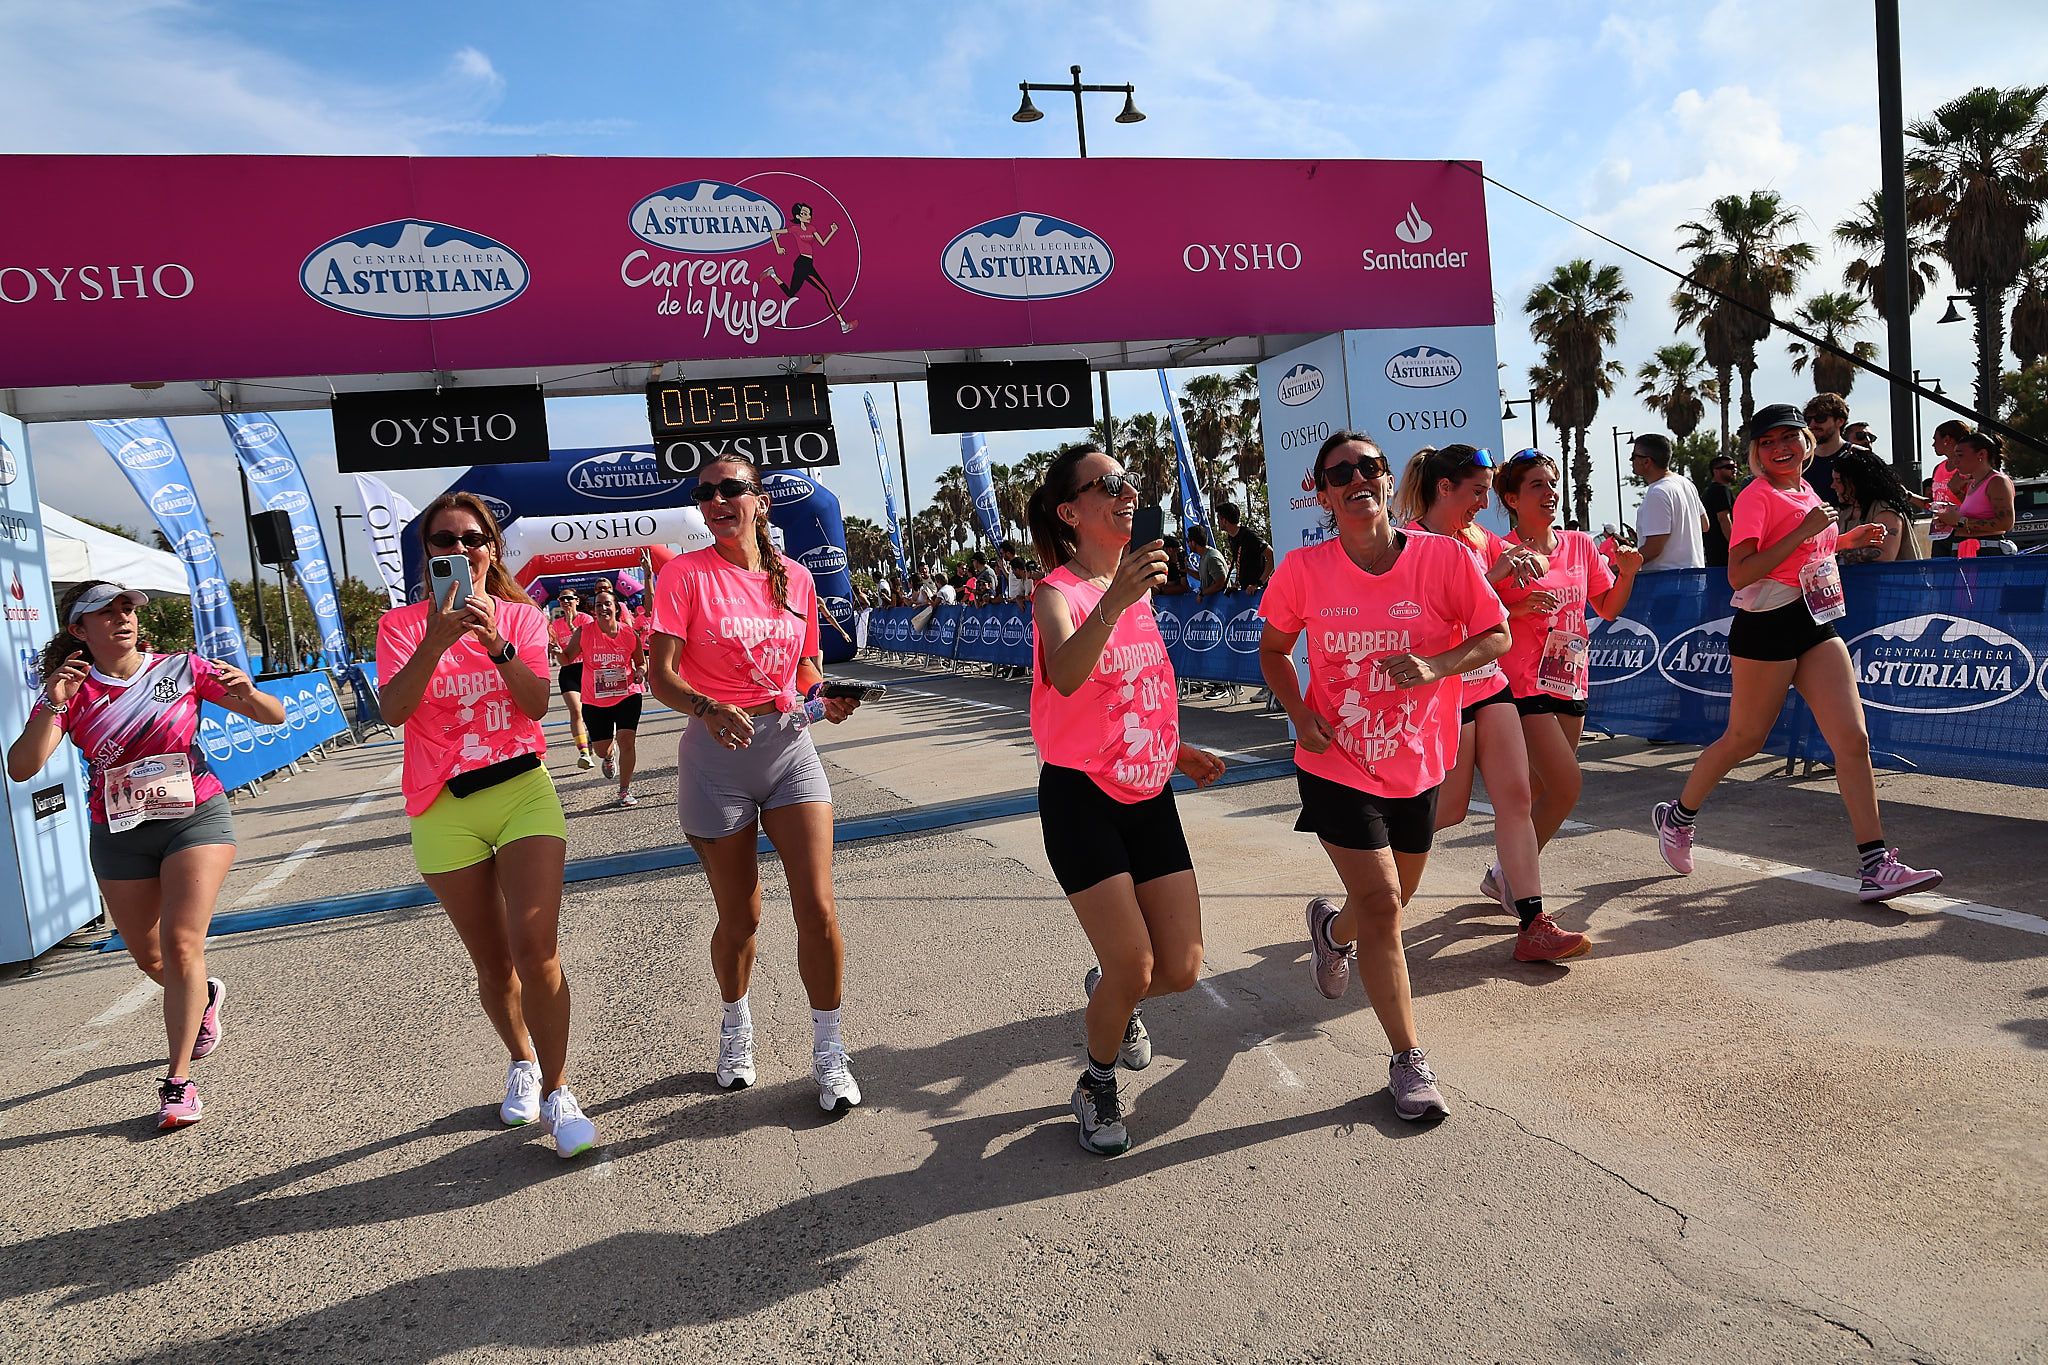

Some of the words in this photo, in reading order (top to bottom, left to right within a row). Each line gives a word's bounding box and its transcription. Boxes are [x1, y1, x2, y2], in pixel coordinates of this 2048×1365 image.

[642, 207, 774, 235] ASTURIANA
[665, 205, 713, 213] CENTRAL
[718, 205, 767, 213] LECHERA
[352, 254, 425, 265] CENTRAL
[432, 253, 503, 263] LECHERA
[981, 243, 1036, 253] CENTRAL
[1041, 242, 1095, 251] LECHERA
[1183, 242, 1303, 273] OYSHO
[1362, 247, 1469, 271] Santander
[620, 250, 751, 288] Carrera
[956, 247, 1102, 280] ASTURIANA
[0, 263, 195, 304] OYSHO
[320, 258, 515, 296] ASTURIANA
[657, 289, 682, 316] de
[686, 288, 704, 315] la
[703, 281, 799, 344] Mujer
[1391, 362, 1457, 378] ASTURIANA
[957, 382, 1070, 410] OYSHO
[1281, 378, 1321, 400] ASTURIANA
[661, 383, 818, 426] 00:36:11
[370, 413, 517, 447] OYSHO
[1388, 408, 1468, 432] OYSHO
[1281, 421, 1330, 451] OYSHO
[665, 432, 829, 474] OYSHO
[1290, 496, 1320, 510] Santan
[0, 514, 27, 541] SHO
[551, 516, 657, 544] OYSHO
[544, 552, 574, 564] Sports
[588, 547, 636, 559] Santander
[1823, 583, 1841, 597] 016
[1320, 606, 1358, 617] OYSHO
[721, 616, 795, 640] CARRERA
[1185, 625, 1219, 641] ASTURIANA
[1228, 625, 1263, 642] ASTURIAN
[1324, 630, 1411, 653] CARRERA
[1699, 640, 1729, 649] CENT
[1875, 647, 1937, 658] CENTRAL
[1944, 649, 2013, 660] LECHERA
[1099, 640, 1165, 676] CARRERA
[1588, 649, 1644, 668] RIANA
[1853, 648, 2013, 692] ASTURIANA
[1363, 709, 1385, 738] LA
[1149, 730, 1168, 762] LA
[134, 786, 167, 801] 016
